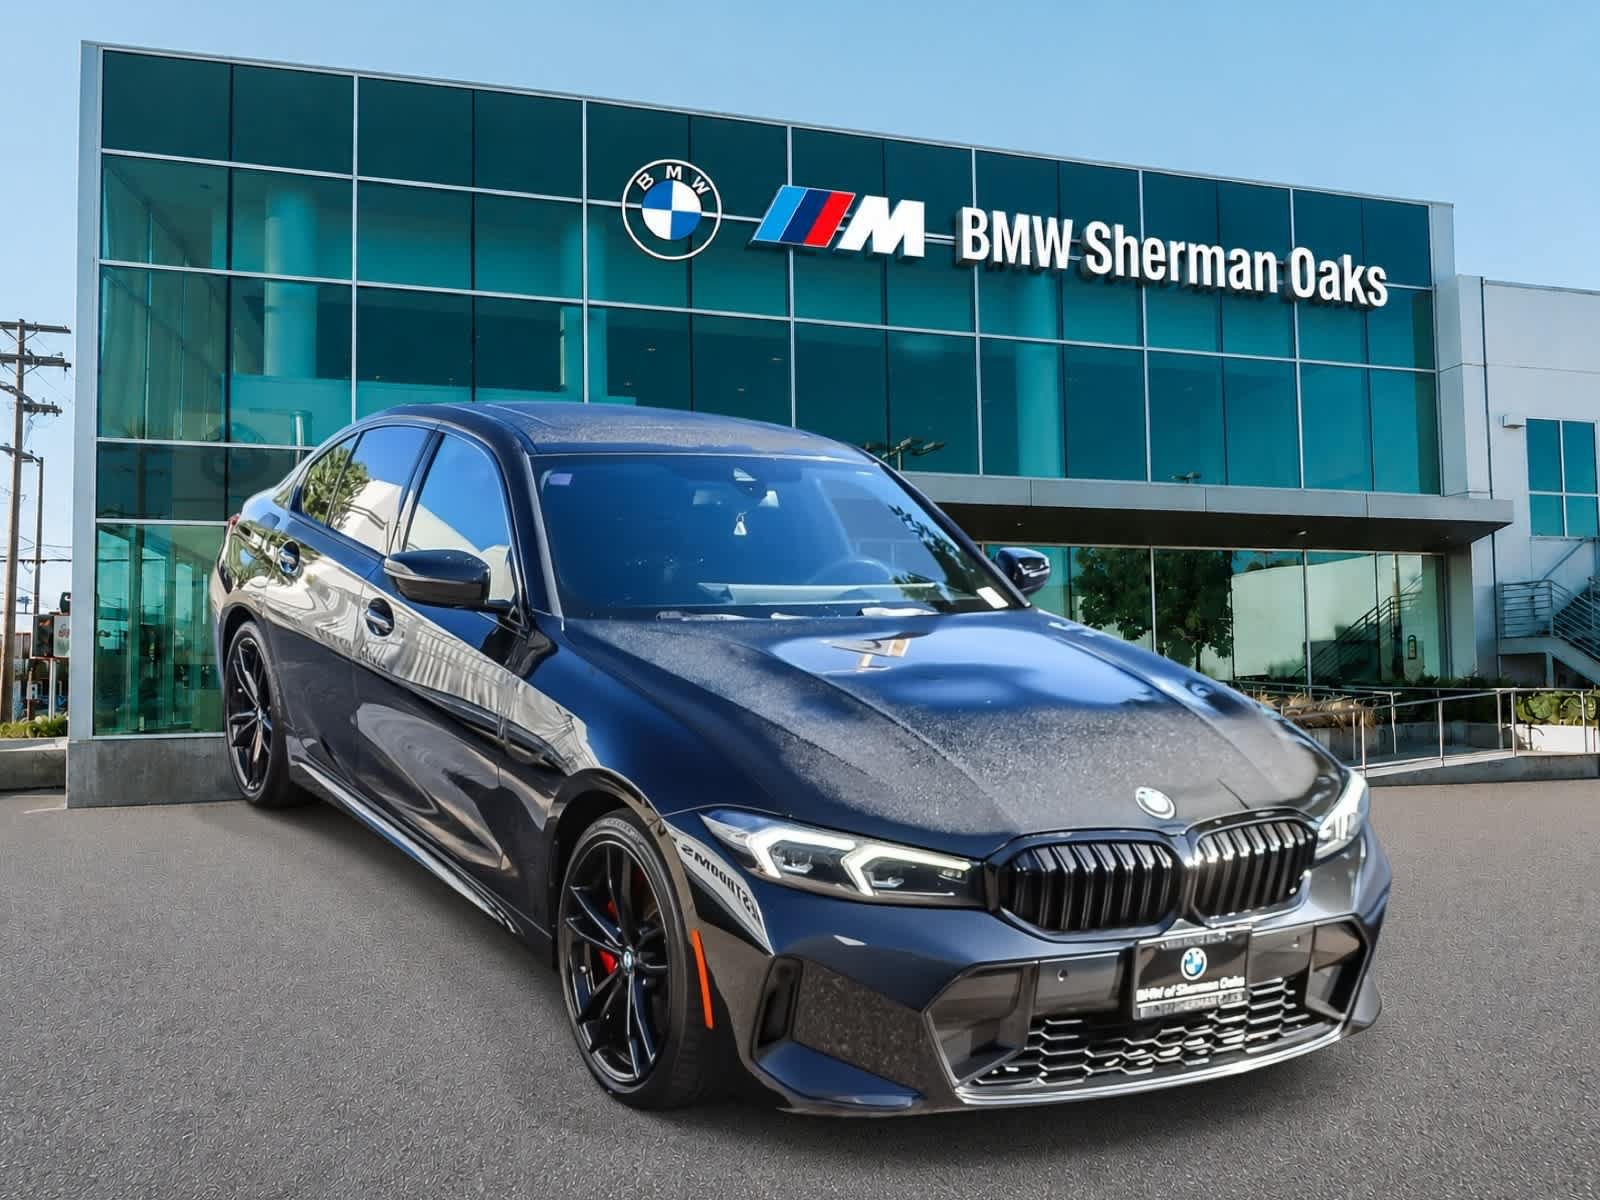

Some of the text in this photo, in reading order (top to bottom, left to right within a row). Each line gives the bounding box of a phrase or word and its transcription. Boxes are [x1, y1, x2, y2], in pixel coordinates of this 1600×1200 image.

[636, 164, 711, 196] BMW
[836, 194, 925, 258] M
[959, 206, 1389, 308] BMW Sherman Oaks
